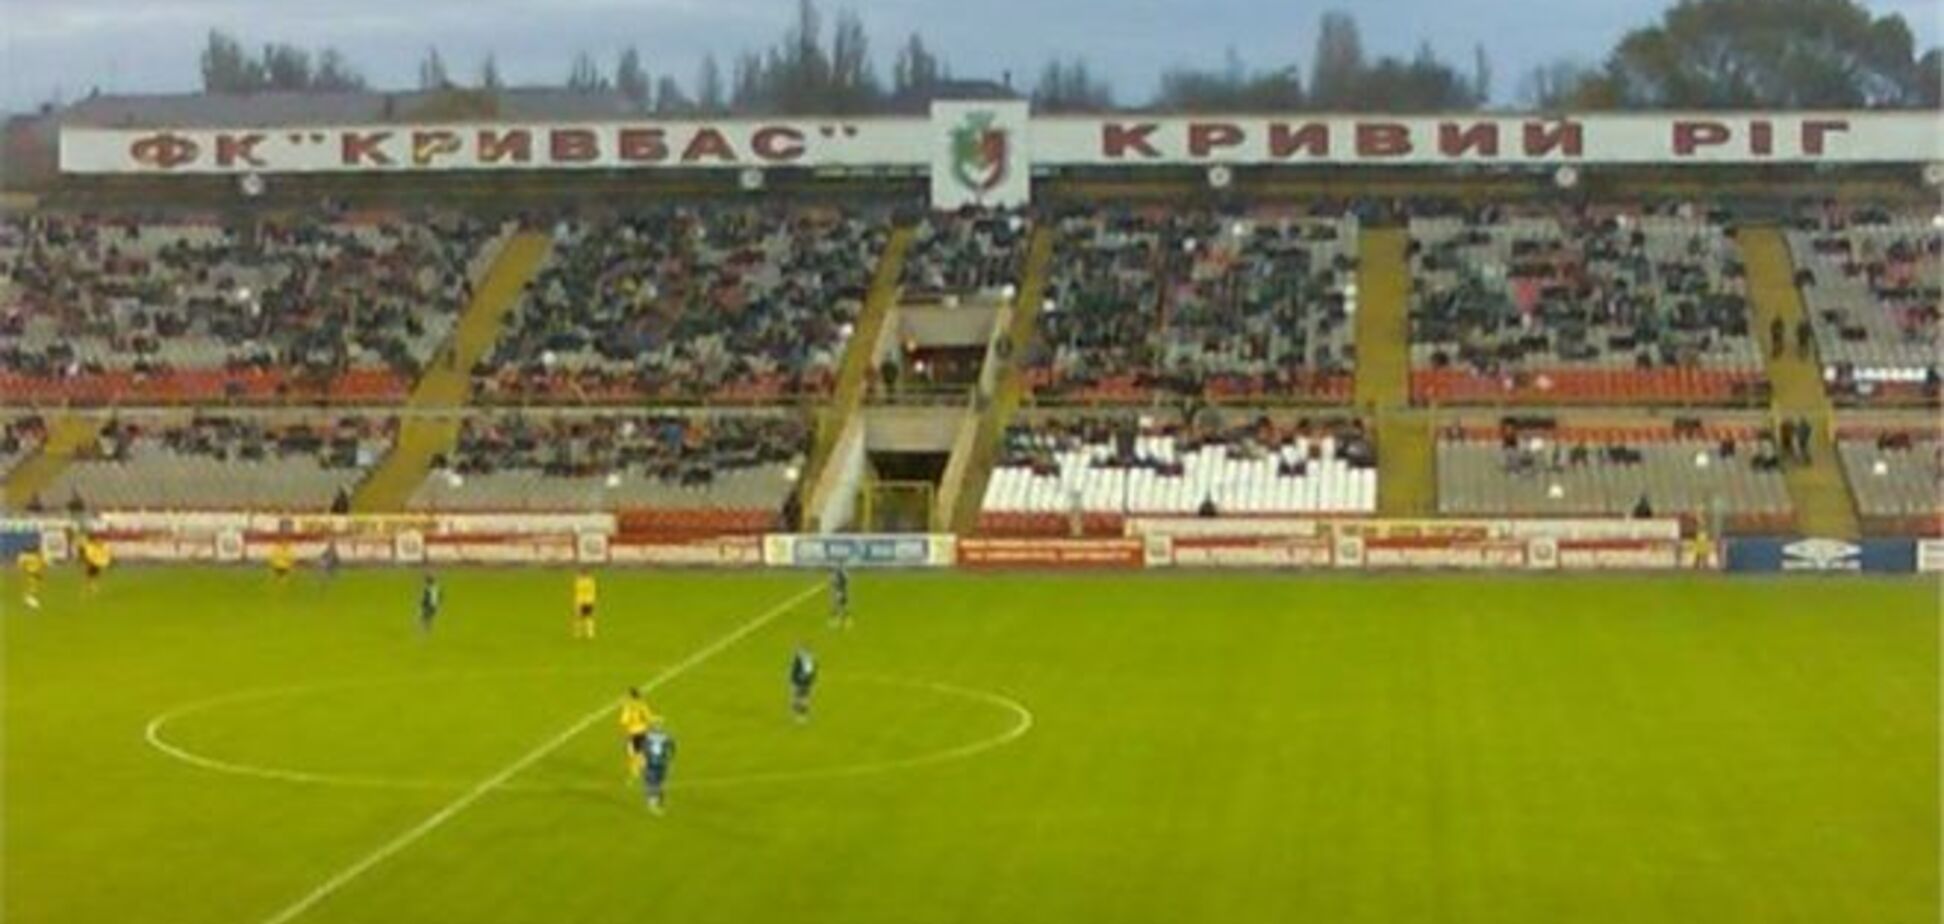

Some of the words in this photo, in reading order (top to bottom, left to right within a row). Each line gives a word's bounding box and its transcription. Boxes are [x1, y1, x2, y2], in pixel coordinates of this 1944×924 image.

[130, 131, 267, 169] ФК
[287, 124, 858, 166] "КРИВБАС"
[1102, 117, 1584, 158] КРИВИЙ
[1672, 119, 1850, 154] РІГ
